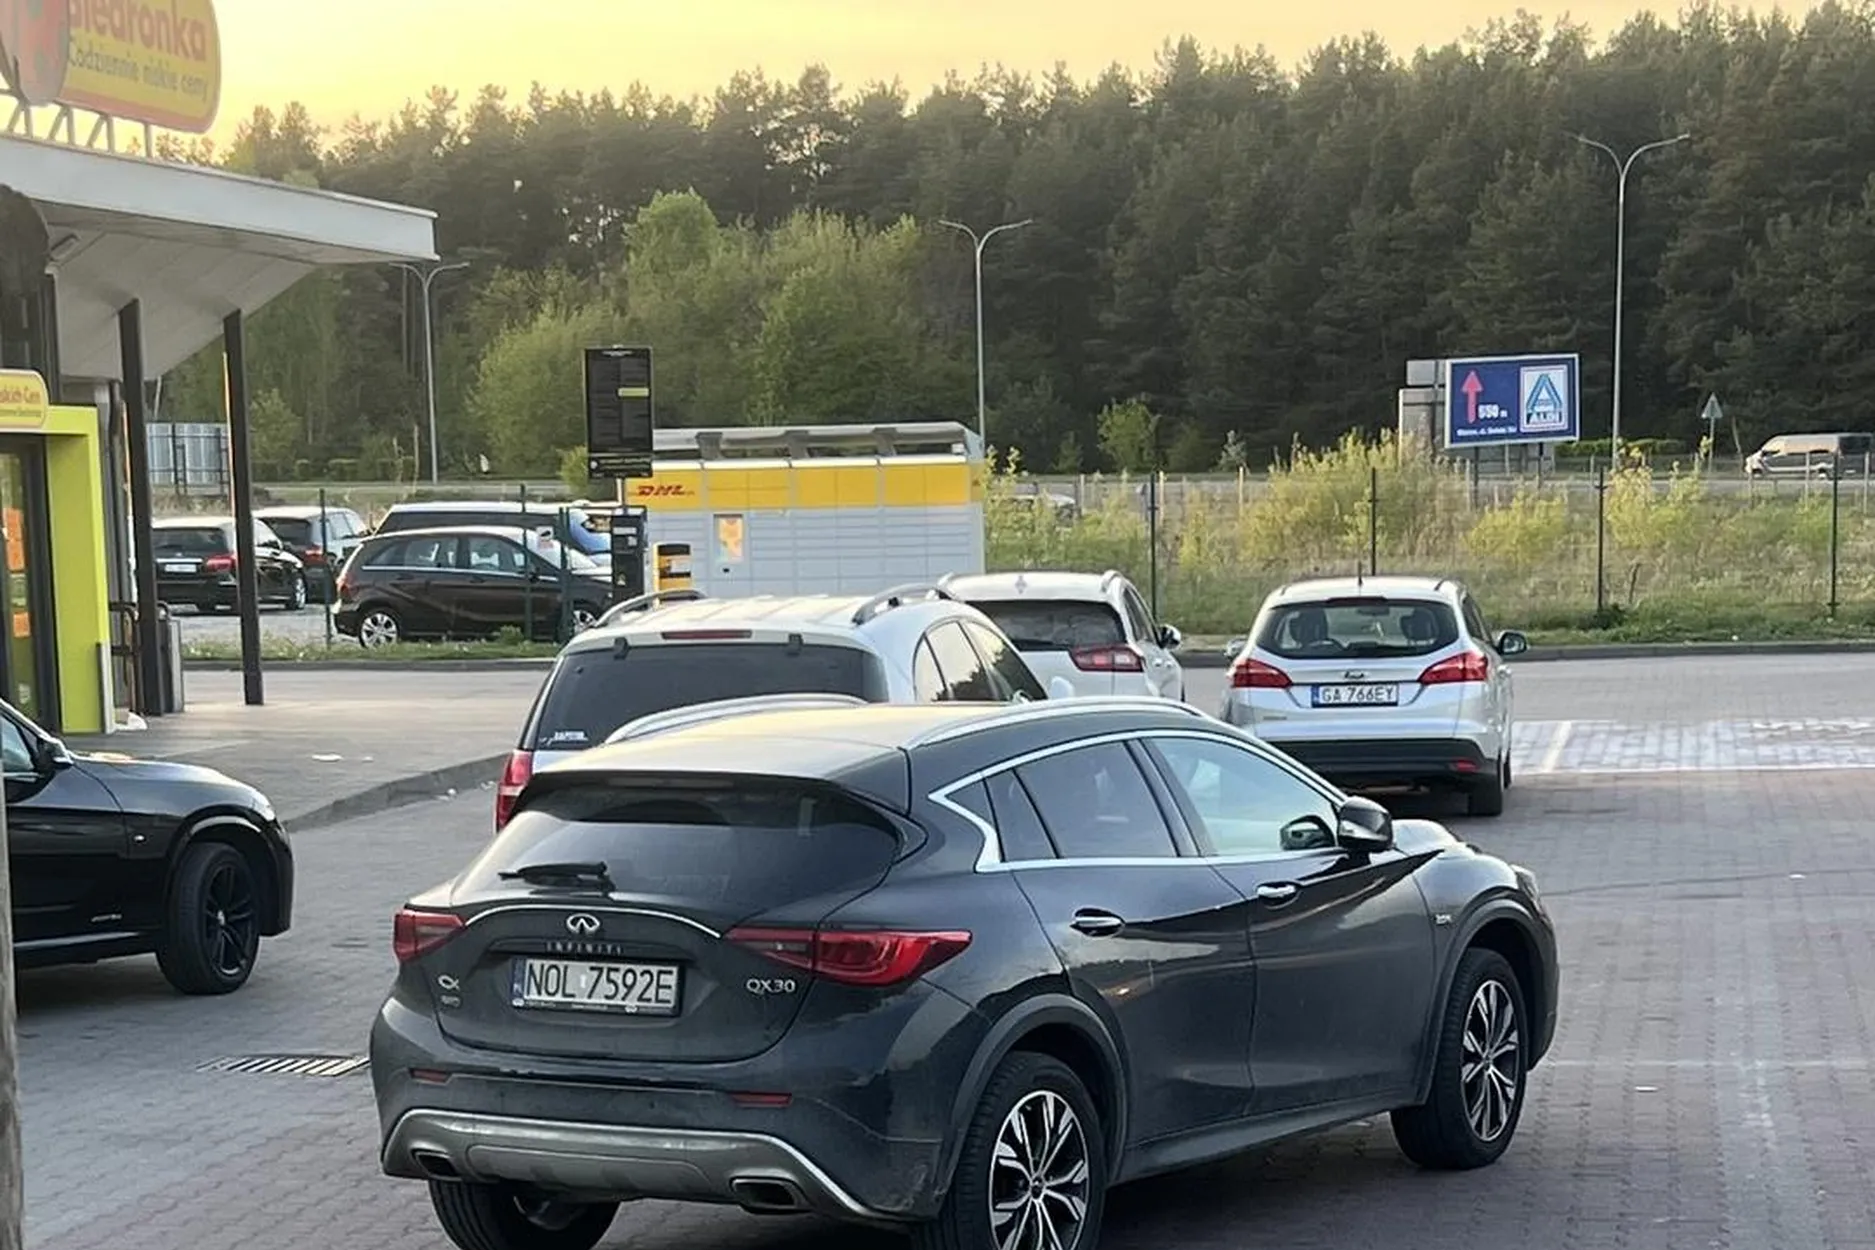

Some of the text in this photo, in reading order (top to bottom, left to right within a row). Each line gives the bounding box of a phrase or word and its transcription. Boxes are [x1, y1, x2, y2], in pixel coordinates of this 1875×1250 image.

[638, 485, 685, 496] DHL
[1322, 686, 1394, 701] GA 766EY
[546, 941, 622, 955] INFINITI
[525, 963, 674, 1004] NOL 7592E
[746, 979, 796, 993] QX30
